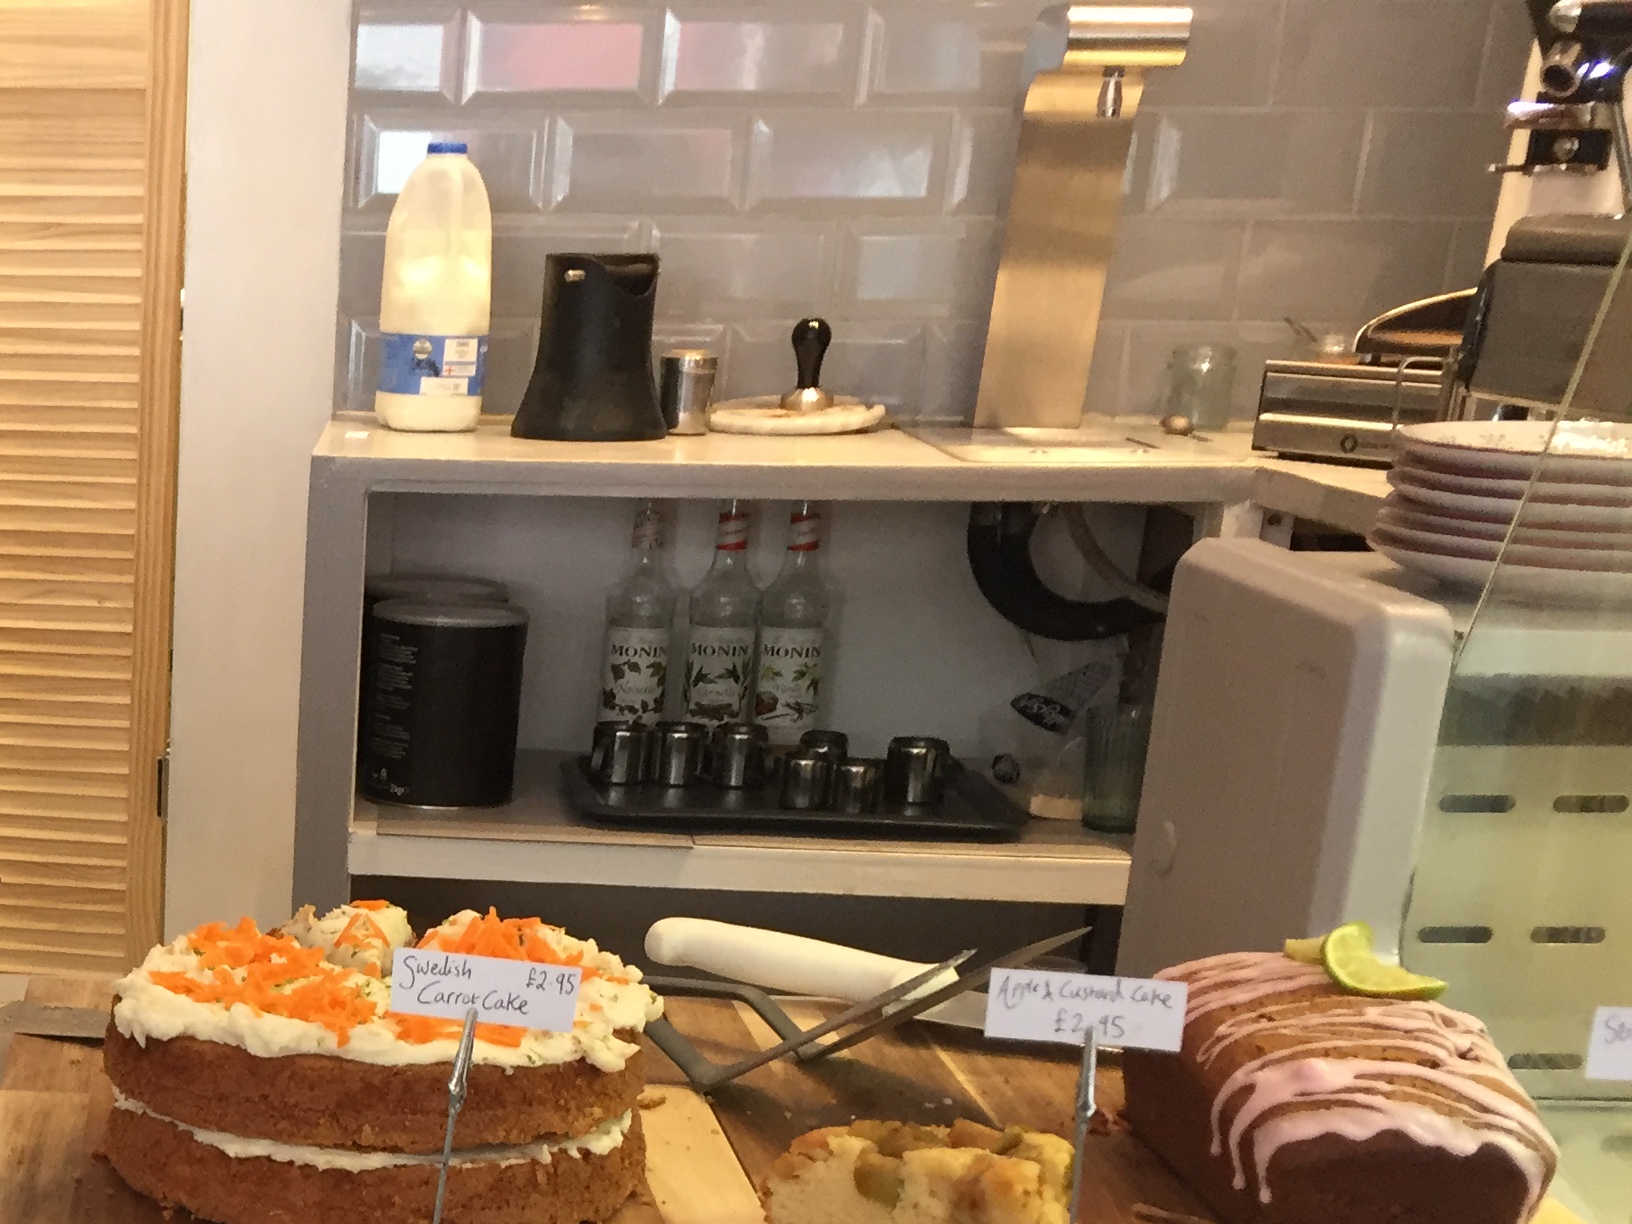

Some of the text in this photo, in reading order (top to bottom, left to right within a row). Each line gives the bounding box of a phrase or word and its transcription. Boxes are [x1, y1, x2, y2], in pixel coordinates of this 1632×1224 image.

[611, 644, 666, 657] MONIN
[763, 644, 821, 658] MONIN
[399, 955, 579, 995] Swedish £2.95
[417, 981, 480, 1005] Carrot
[998, 976, 1039, 1009] Apple
[1059, 979, 1124, 1003] Custard
[1054, 1007, 1124, 1039] £295
